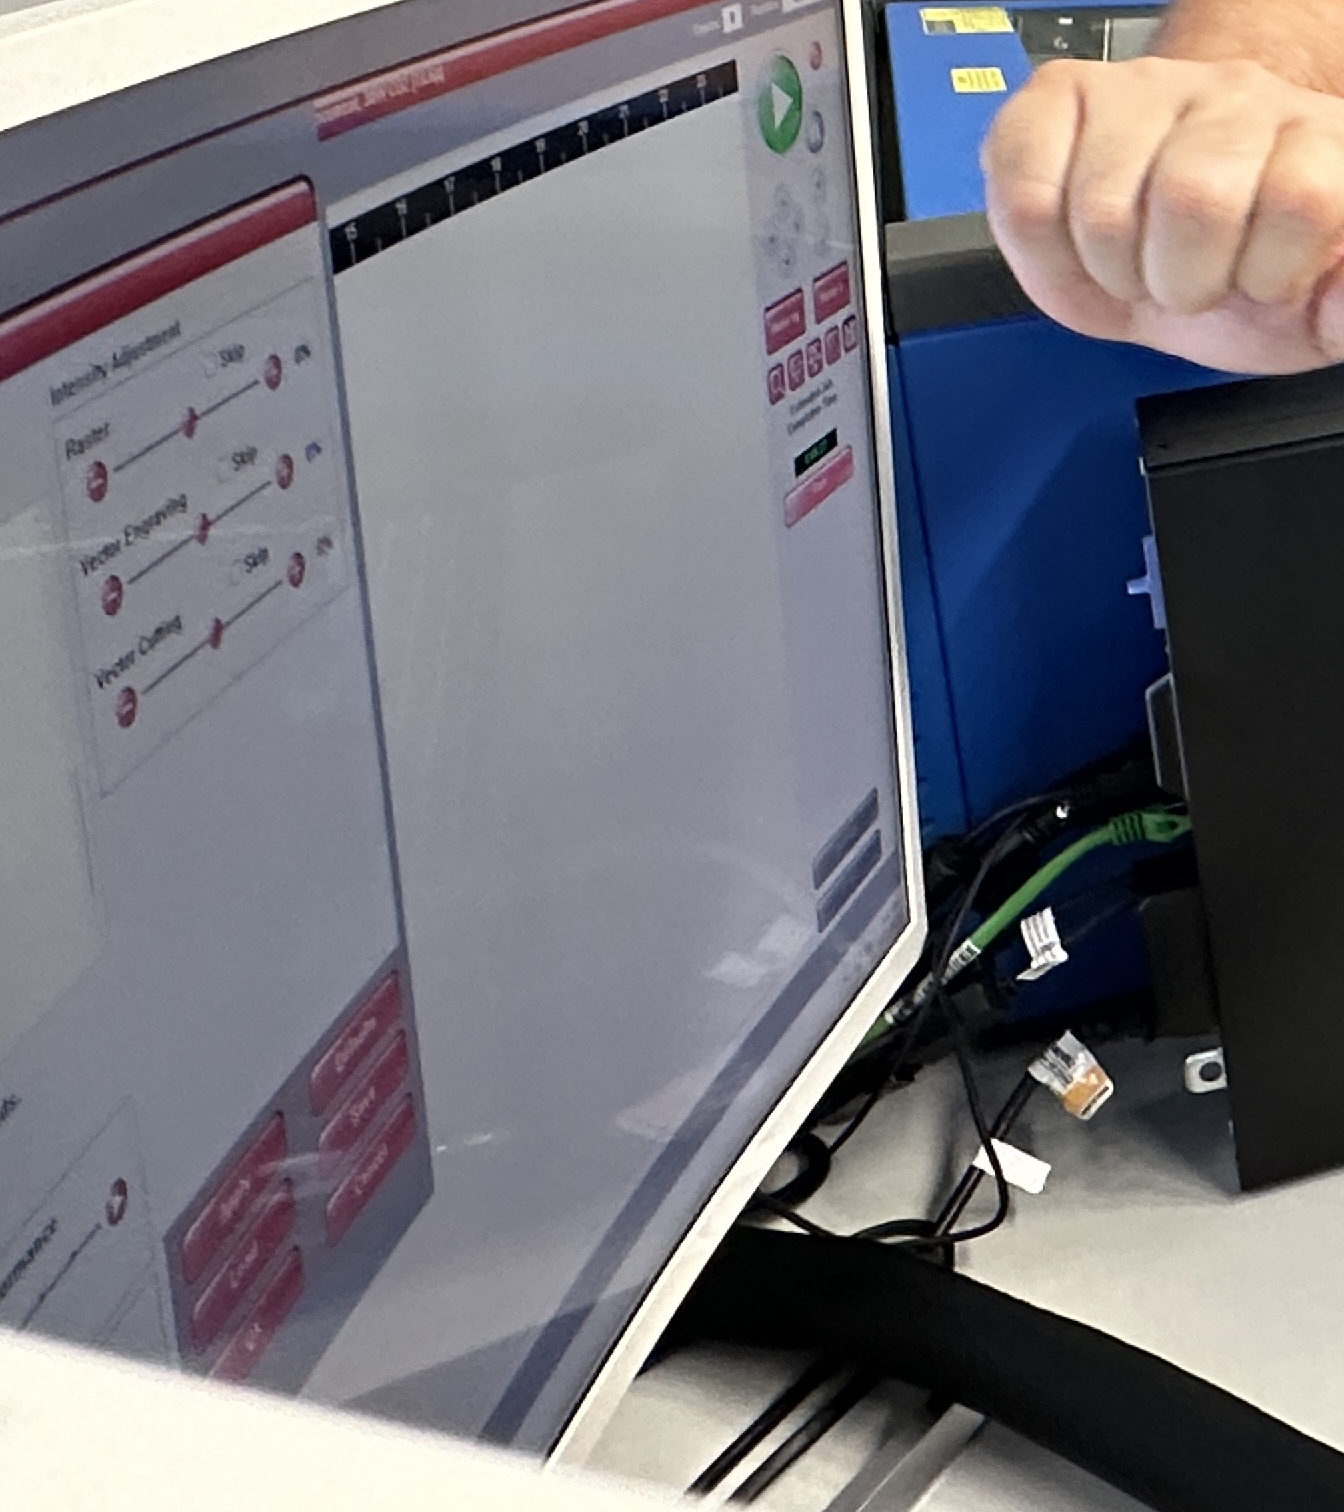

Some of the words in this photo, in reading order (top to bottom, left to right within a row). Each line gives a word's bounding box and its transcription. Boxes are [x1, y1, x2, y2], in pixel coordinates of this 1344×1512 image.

[50, 364, 109, 406] Intensity
[111, 319, 181, 371] Adjustment
[219, 343, 246, 368] Skip
[65, 423, 111, 461] Raster
[231, 445, 258, 472] Skip
[80, 541, 121, 578] Vector
[124, 493, 189, 547] Engraving
[243, 546, 270, 574] Skip
[94, 653, 135, 689] Vector
[138, 614, 184, 657] Cutting
